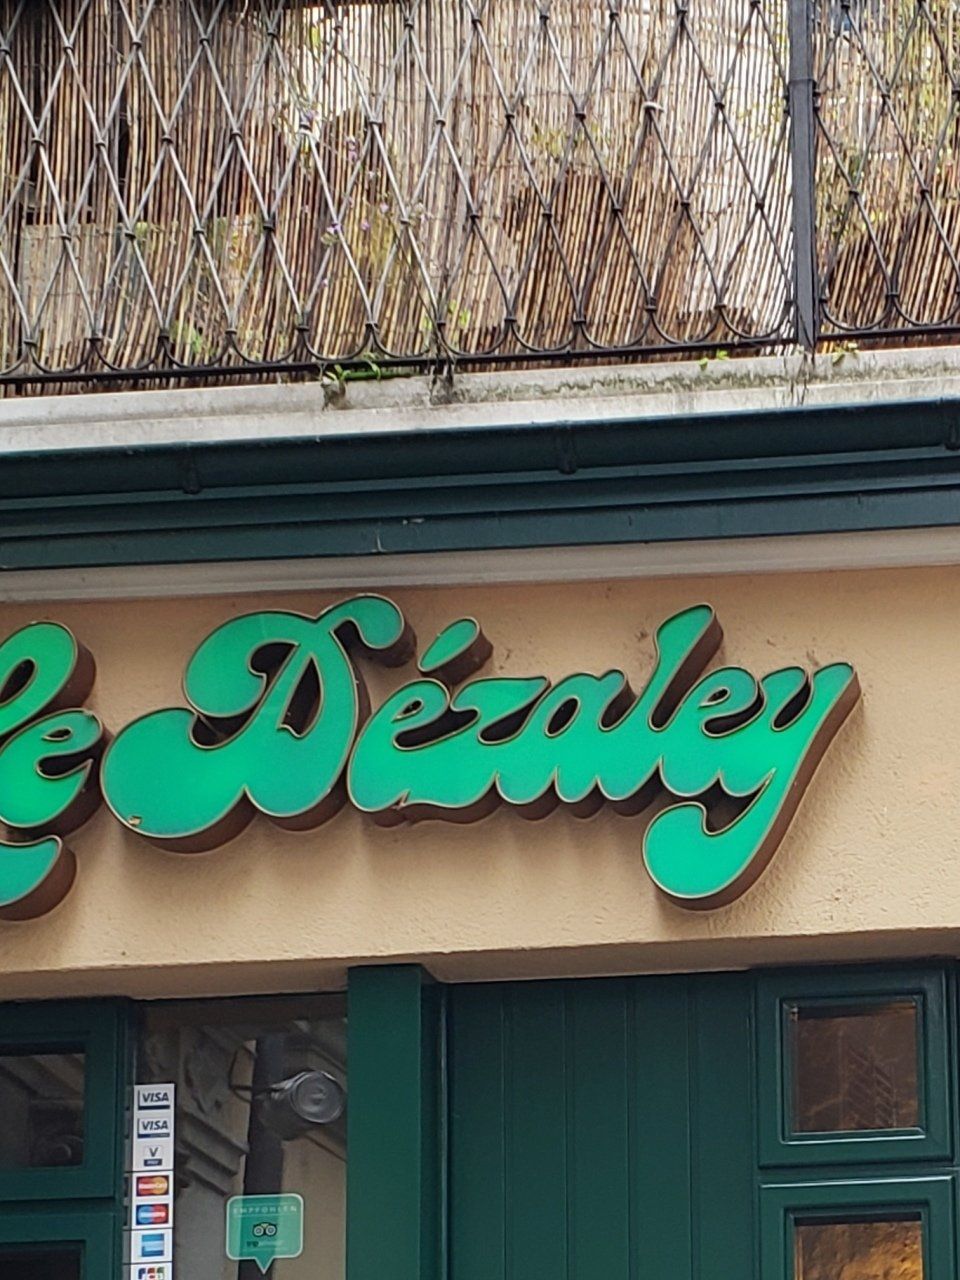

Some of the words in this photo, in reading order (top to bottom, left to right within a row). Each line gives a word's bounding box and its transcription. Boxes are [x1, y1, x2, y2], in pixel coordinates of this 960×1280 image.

[101, 593, 862, 908] Dézaley
[142, 1092, 170, 1102] VISA
[141, 1120, 169, 1131] VISA
